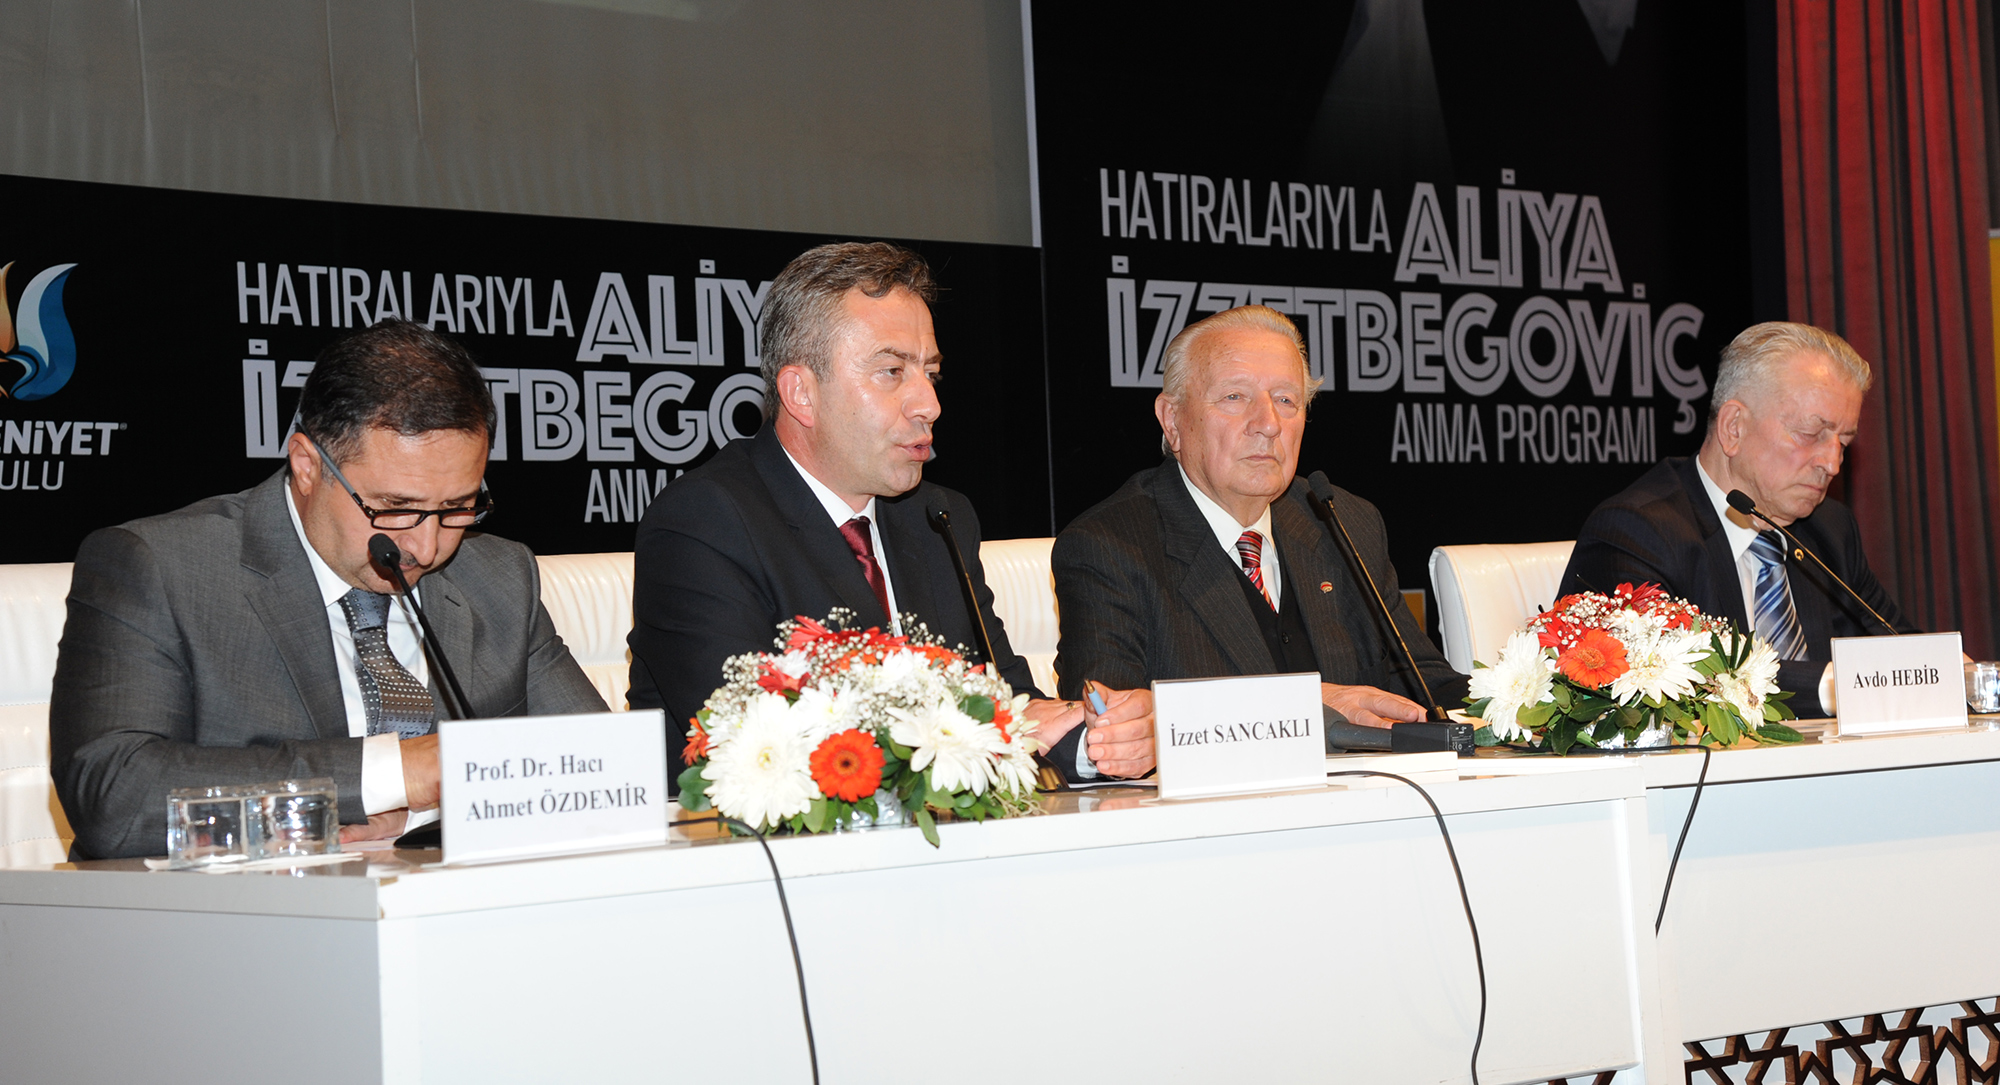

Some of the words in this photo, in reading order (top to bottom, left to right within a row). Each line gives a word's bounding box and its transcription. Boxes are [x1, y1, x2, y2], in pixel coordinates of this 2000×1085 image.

[1100, 167, 1392, 253] HATIRALARIYLA
[1395, 168, 1625, 294] ALİYA
[575, 259, 774, 368] ALİY
[1107, 255, 1707, 434] İZTBEGOVİÇ
[1390, 402, 1488, 464] ANMA
[1496, 403, 1657, 464] PROGRAMI
[583, 468, 685, 523] ANM
[1853, 671, 1888, 689] Avdo
[1891, 664, 1940, 687] HEBİB
[1170, 723, 1209, 747] İzzet
[1214, 718, 1311, 744] SANCAKLI
[465, 760, 515, 782] Prof.
[522, 757, 553, 778] Dr.
[560, 754, 604, 775] Hacı
[466, 797, 533, 821] Ahmet
[540, 783, 648, 814] ÖZDEMİR
